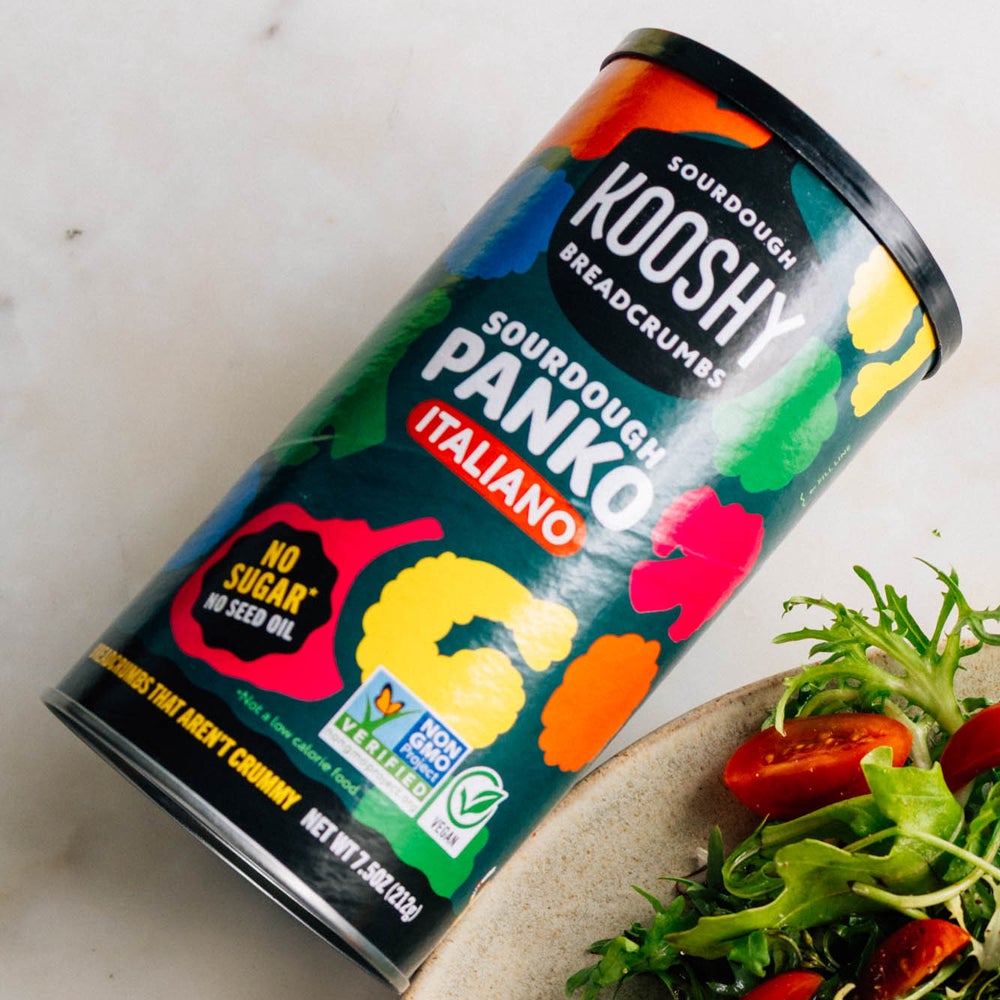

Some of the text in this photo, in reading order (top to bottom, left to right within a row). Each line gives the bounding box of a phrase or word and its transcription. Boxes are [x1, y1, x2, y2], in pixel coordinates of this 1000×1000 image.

[667, 155, 797, 271] SOURDOUGH
[569, 161, 806, 370] KOOSHY
[558, 241, 726, 389] BREADCRUMBS
[420, 326, 654, 531] PANKO
[481, 311, 666, 470] SOURDOUGH
[415, 405, 576, 546] ITALIANO
[260, 539, 301, 574] NO
[203, 592, 295, 642] NO SEED OIL
[147, 682, 188, 718] THAT
[176, 707, 238, 757] AREN'T
[227, 747, 302, 811] CRUMMY
[261, 712, 272, 722] a
[269, 716, 293, 739] low
[291, 737, 332, 772] calorie
[342, 717, 428, 798] VERIFIED
[400, 742, 440, 785] Project
[409, 733, 451, 772] GMO
[420, 718, 464, 759] NON
[300, 807, 424, 923] NET WT 7.5OZ (212g)
[430, 816, 460, 847] VEGAN
